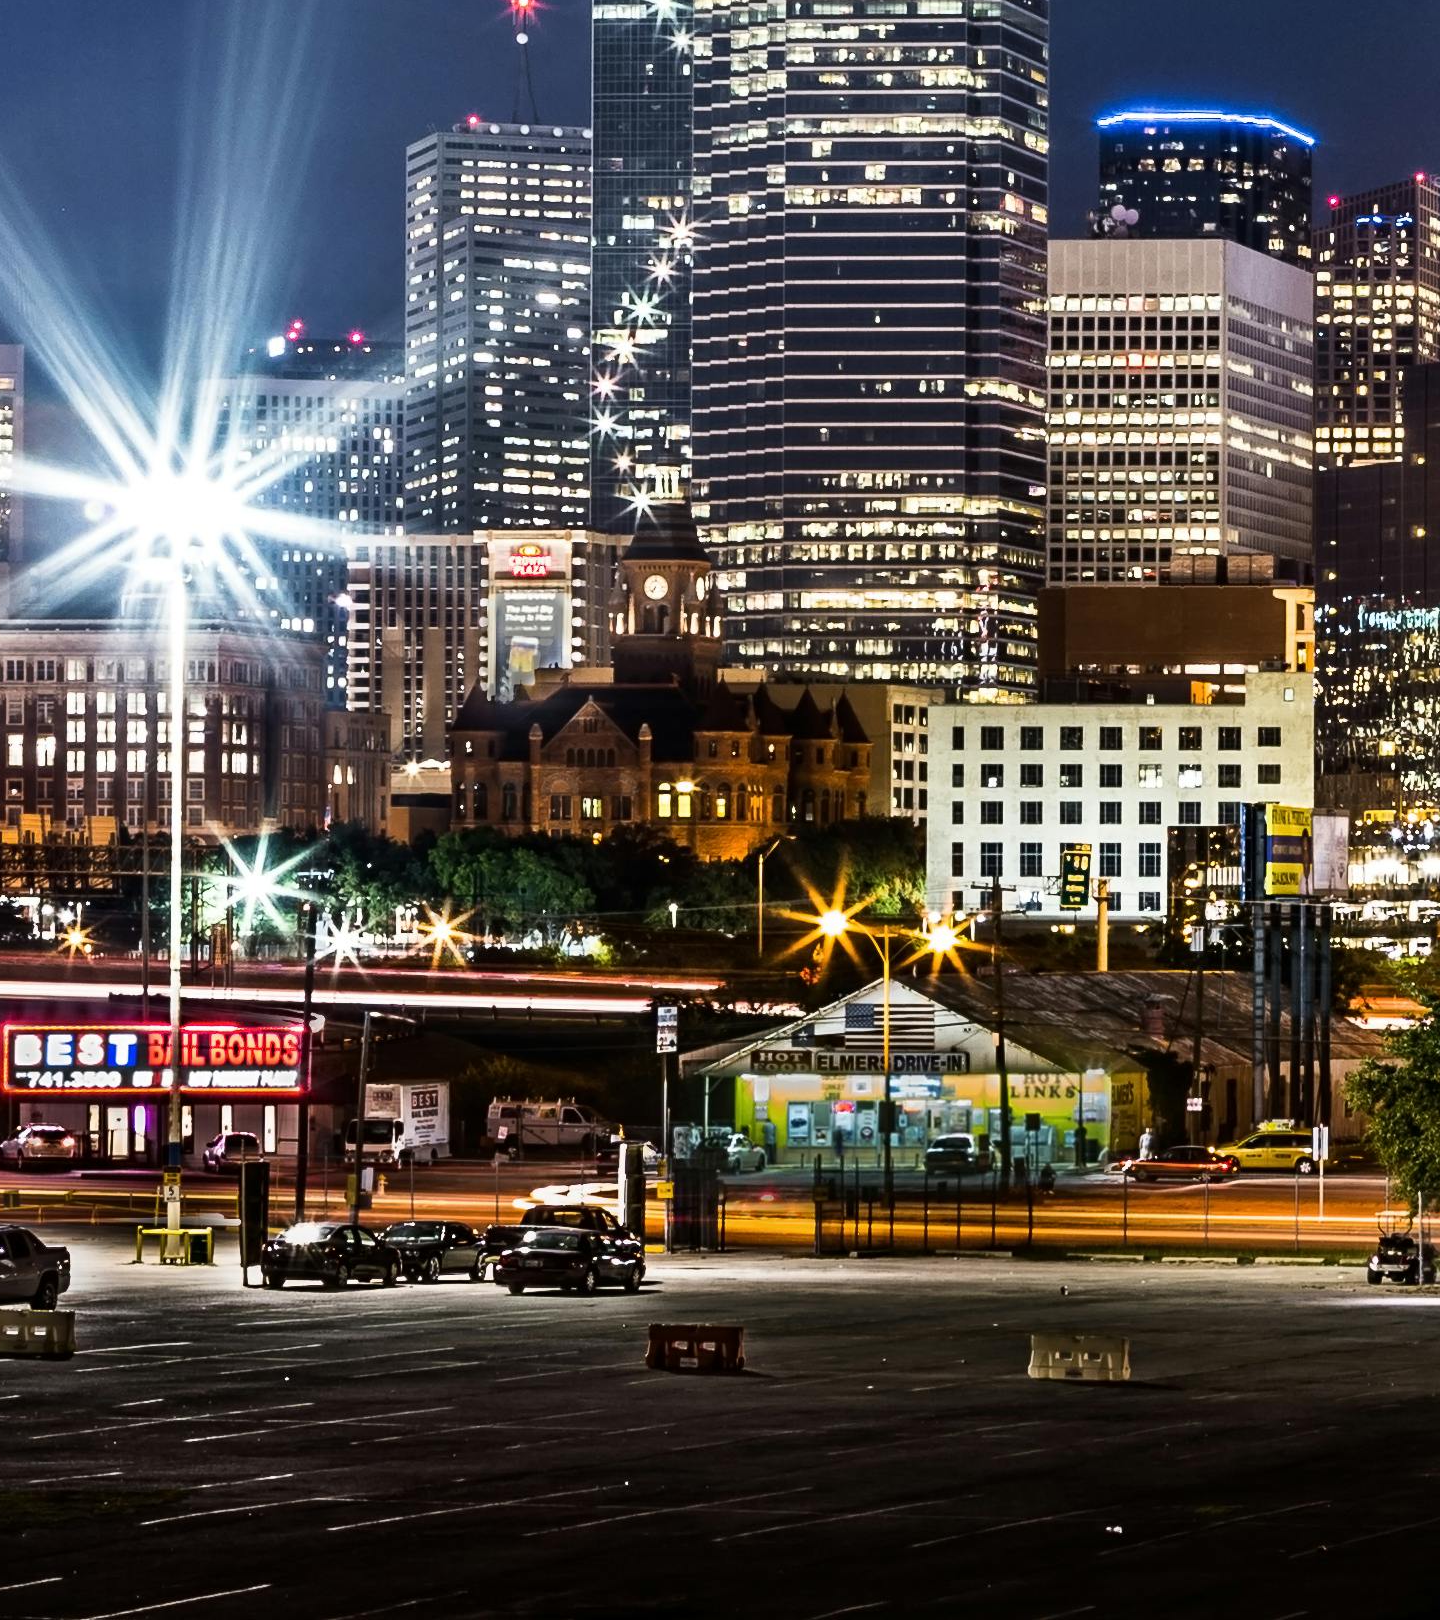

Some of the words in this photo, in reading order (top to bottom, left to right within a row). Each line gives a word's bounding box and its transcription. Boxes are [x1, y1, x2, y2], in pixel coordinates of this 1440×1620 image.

[513, 565, 547, 575] PLAZA
[14, 1034, 138, 1066] BEST
[210, 1033, 299, 1066] BONDS
[759, 1052, 803, 1062] HOT
[893, 1054, 962, 1072] DRIVE-IN
[754, 1063, 811, 1071] FOOD
[1024, 1073, 1062, 1084] HOT
[1010, 1085, 1076, 1098] LINKS
[412, 1093, 438, 1107] BEST
